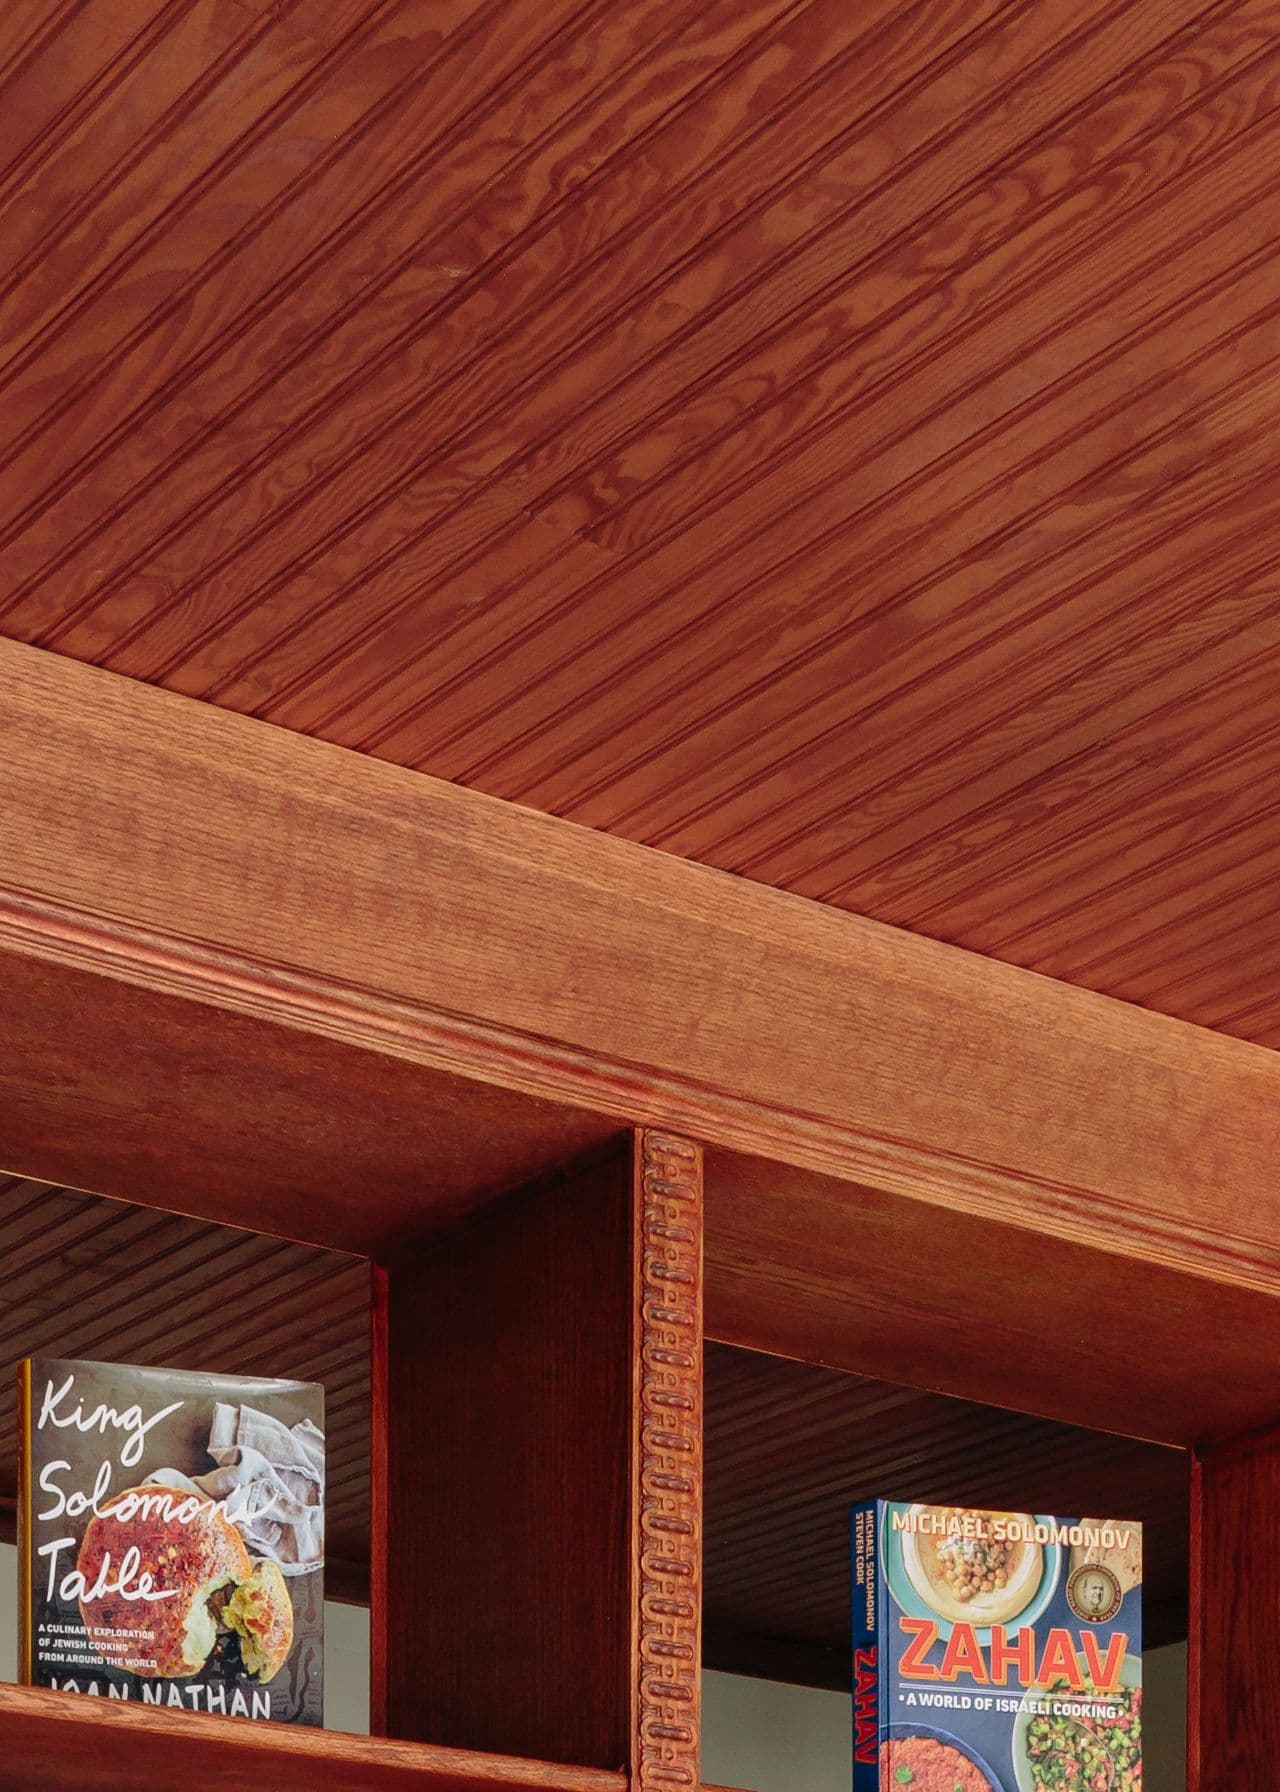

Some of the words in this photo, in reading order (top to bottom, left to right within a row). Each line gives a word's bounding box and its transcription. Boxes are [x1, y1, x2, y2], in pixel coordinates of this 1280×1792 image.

[38, 1375, 184, 1467] King
[866, 1510, 874, 1560] MICHAEL
[892, 1511, 988, 1539] MICHAEL
[993, 1521, 1131, 1549] SOLOMONOV
[37, 1537, 179, 1603] Table
[856, 1556, 864, 1585] COOK
[866, 1562, 875, 1631] SOLOMONOV
[38, 1624, 46, 1632] A
[47, 1624, 92, 1635] CULINARY
[94, 1627, 154, 1639] EXPLORATION
[38, 1638, 50, 1647] OF
[52, 1639, 87, 1649] JEWISH
[88, 1641, 128, 1651] COOKING
[38, 1653, 64, 1662] FROM
[66, 1654, 104, 1665] AROUND
[106, 1657, 123, 1666] THE
[125, 1658, 157, 1668] WORLD
[898, 1616, 1128, 1693] ZAHAV
[143, 1683, 270, 1719] NATHAN
[854, 1648, 877, 1764] ZAHAV
[906, 1693, 917, 1706] A
[919, 1693, 970, 1710] WORLD
[975, 1698, 993, 1711] OF
[996, 1699, 1050, 1715] ISRAELI
[1053, 1703, 1116, 1719] COOKING
